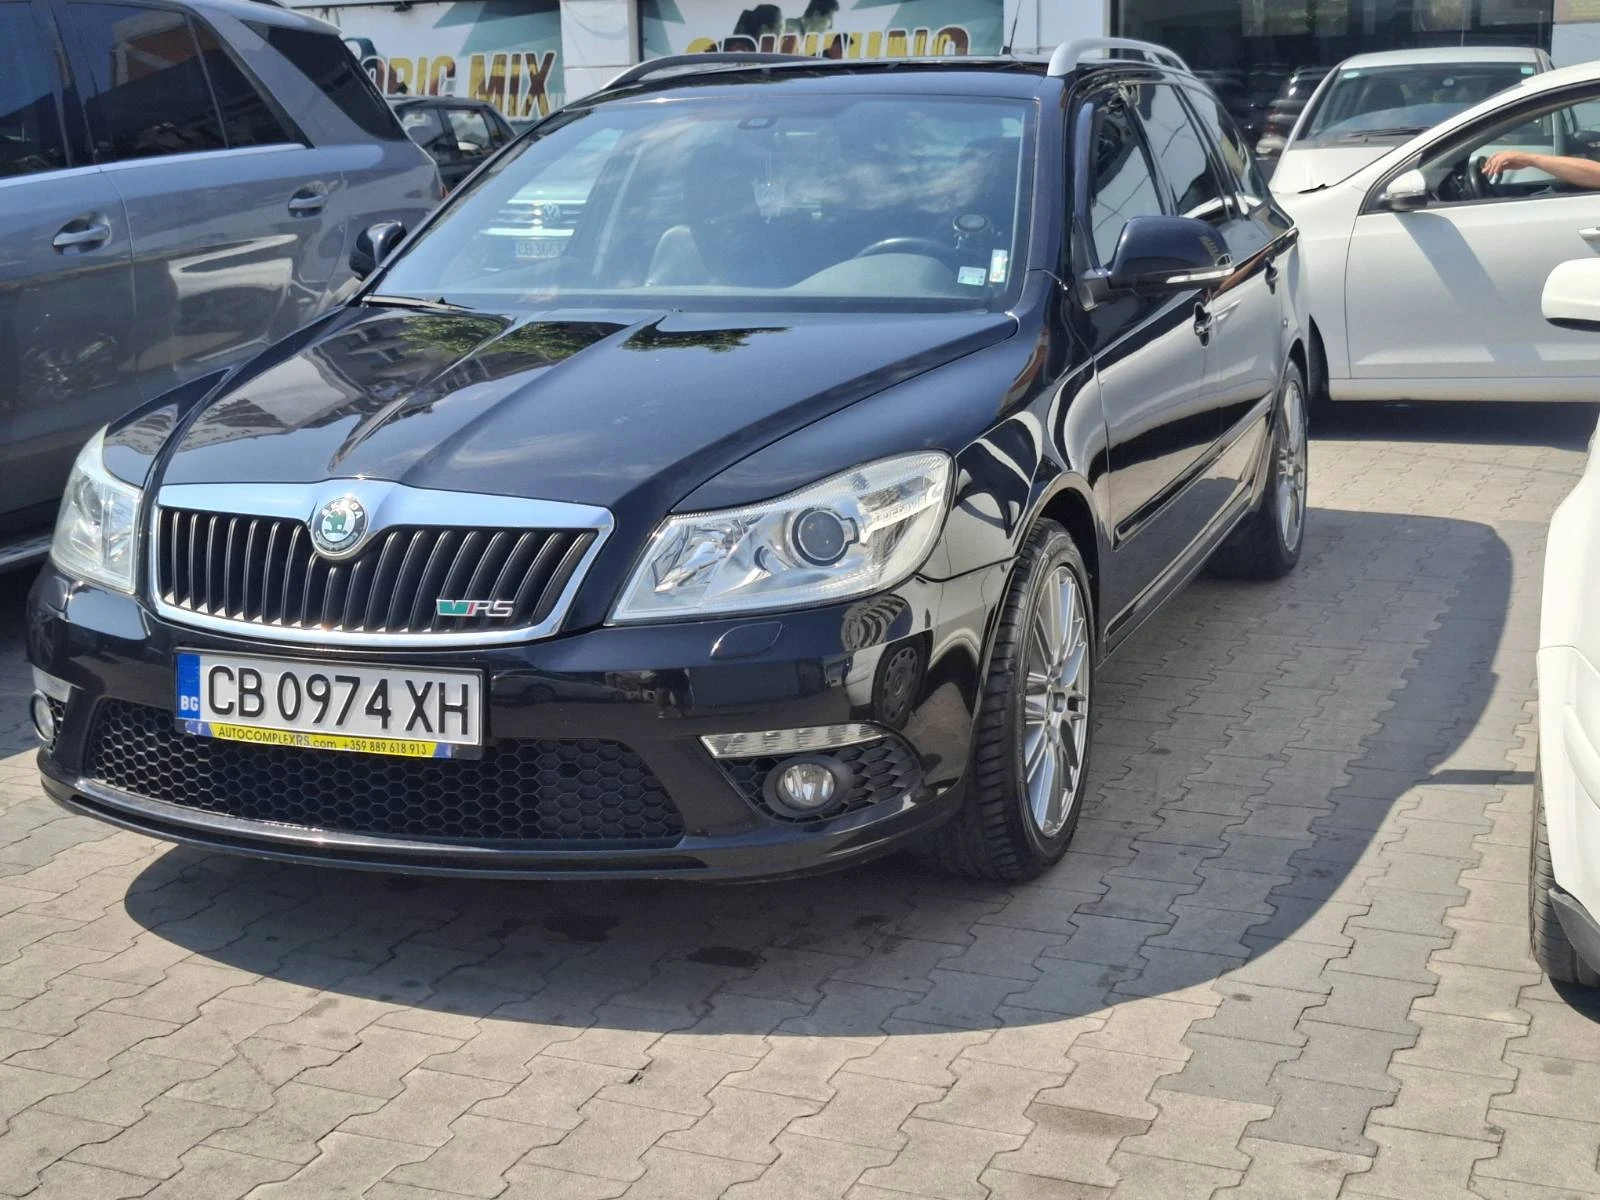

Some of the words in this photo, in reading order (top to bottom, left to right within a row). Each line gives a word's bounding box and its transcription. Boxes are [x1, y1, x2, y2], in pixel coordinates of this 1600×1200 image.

[468, 52, 557, 118] MIX
[180, 695, 199, 712] BG
[208, 665, 264, 718] CB
[276, 671, 392, 730] 0974
[405, 679, 469, 736] XH
[343, 740, 367, 750] +359
[369, 741, 387, 753] 889
[389, 743, 407, 754] 618
[409, 745, 427, 756] 913
